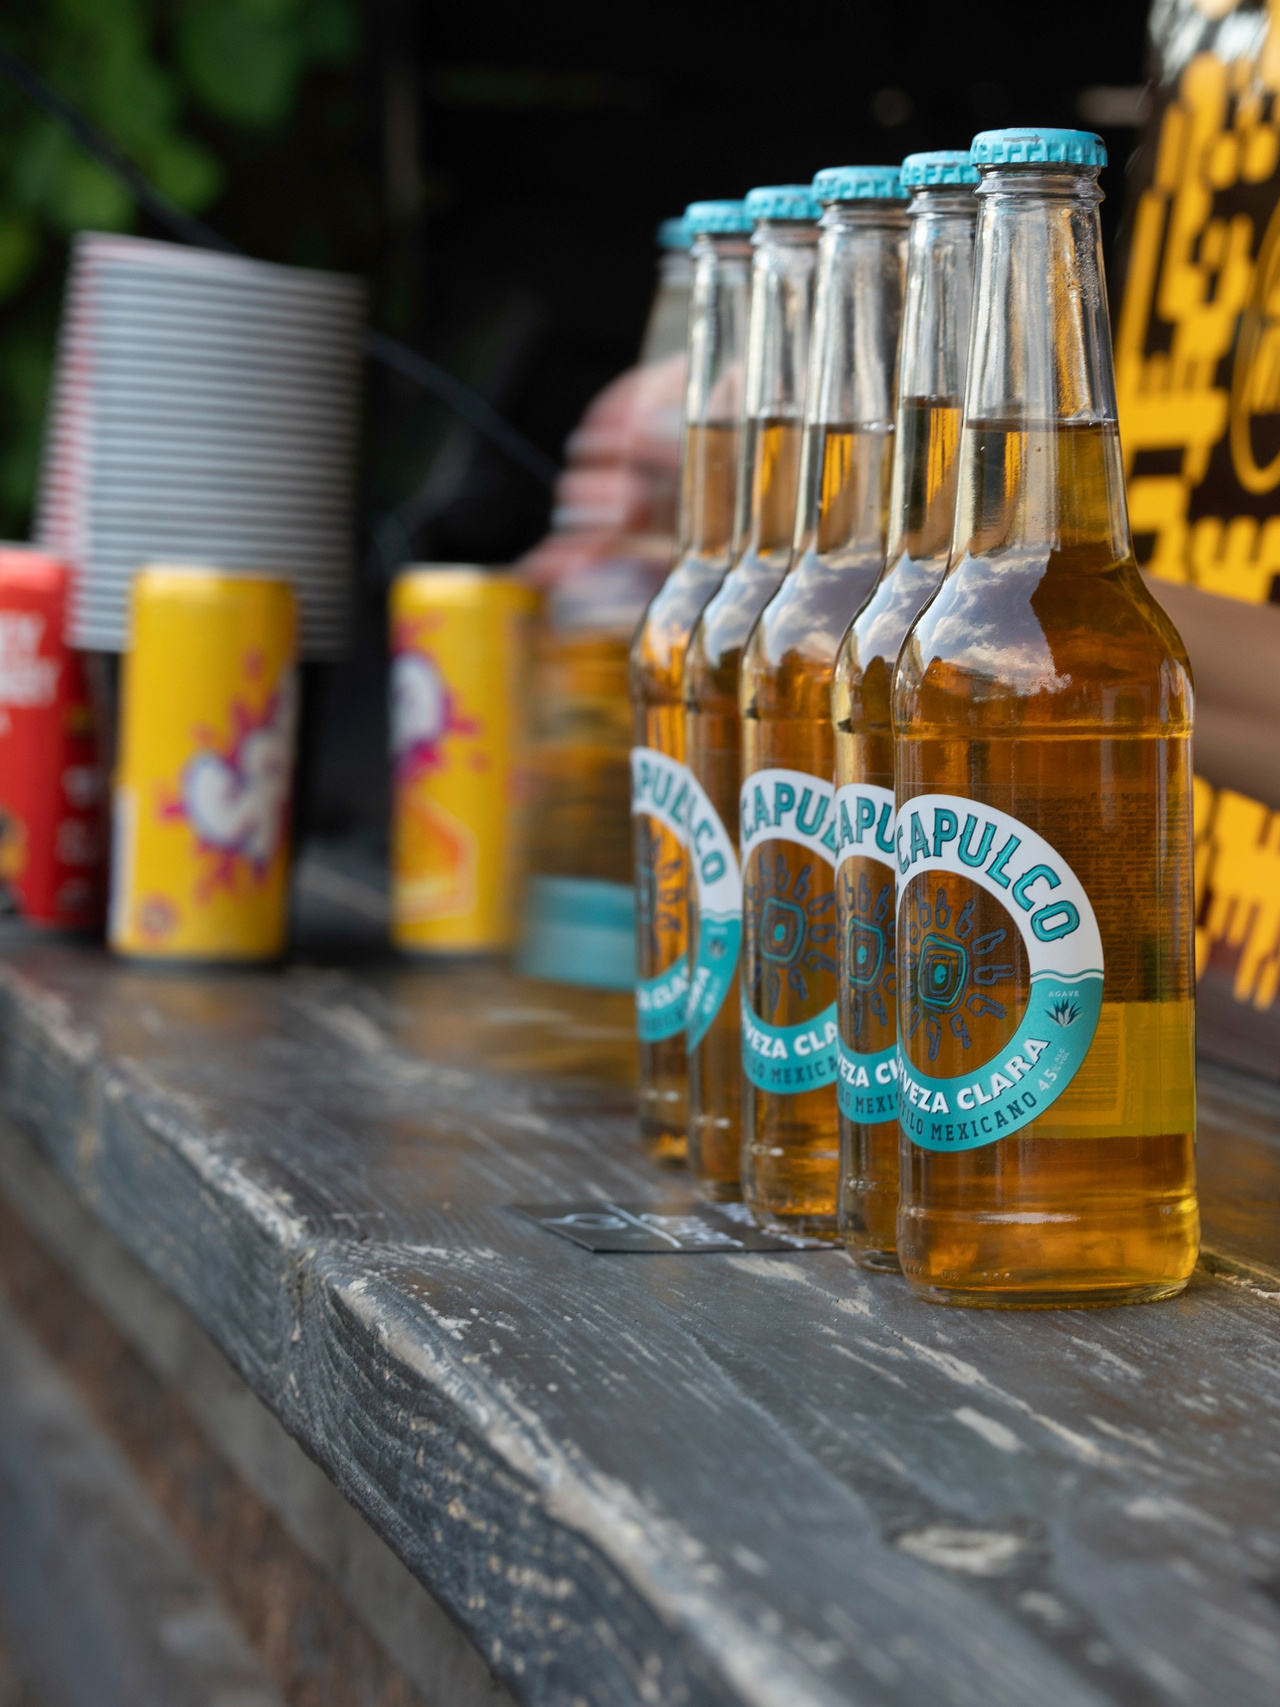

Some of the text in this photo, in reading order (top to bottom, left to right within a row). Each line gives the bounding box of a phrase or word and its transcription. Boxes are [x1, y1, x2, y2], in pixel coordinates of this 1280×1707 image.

[896, 807, 1081, 943] CAPULCO
[1048, 990, 1080, 998] AGAVE
[793, 1021, 838, 1057] CLA
[956, 1037, 1052, 1111] CLARA
[930, 1090, 1038, 1142] MEXICANO
